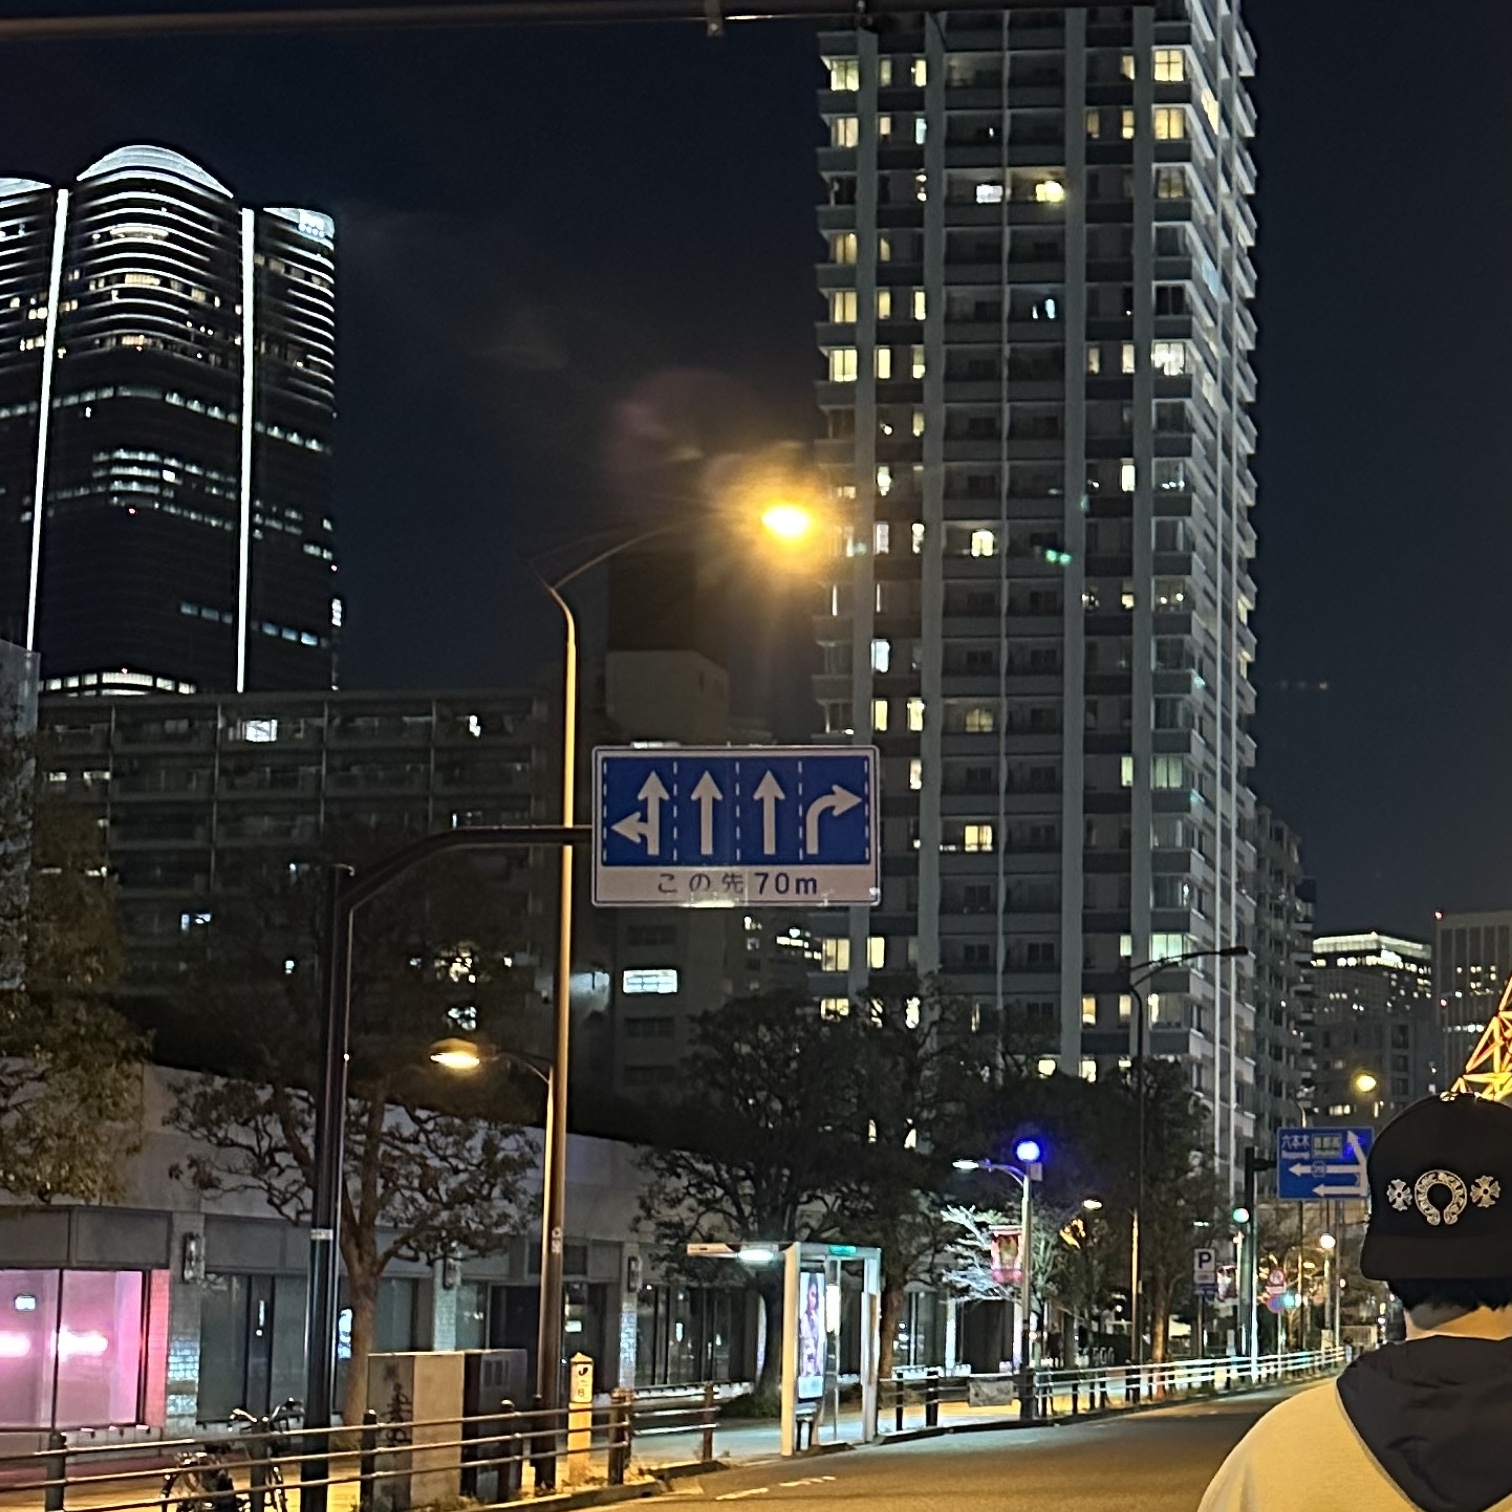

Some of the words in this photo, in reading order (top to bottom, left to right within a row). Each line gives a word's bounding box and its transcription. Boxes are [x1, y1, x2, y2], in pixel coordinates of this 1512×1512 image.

[1281, 1134, 1310, 1150] 六本木
[1198, 1252, 1211, 1269] P
